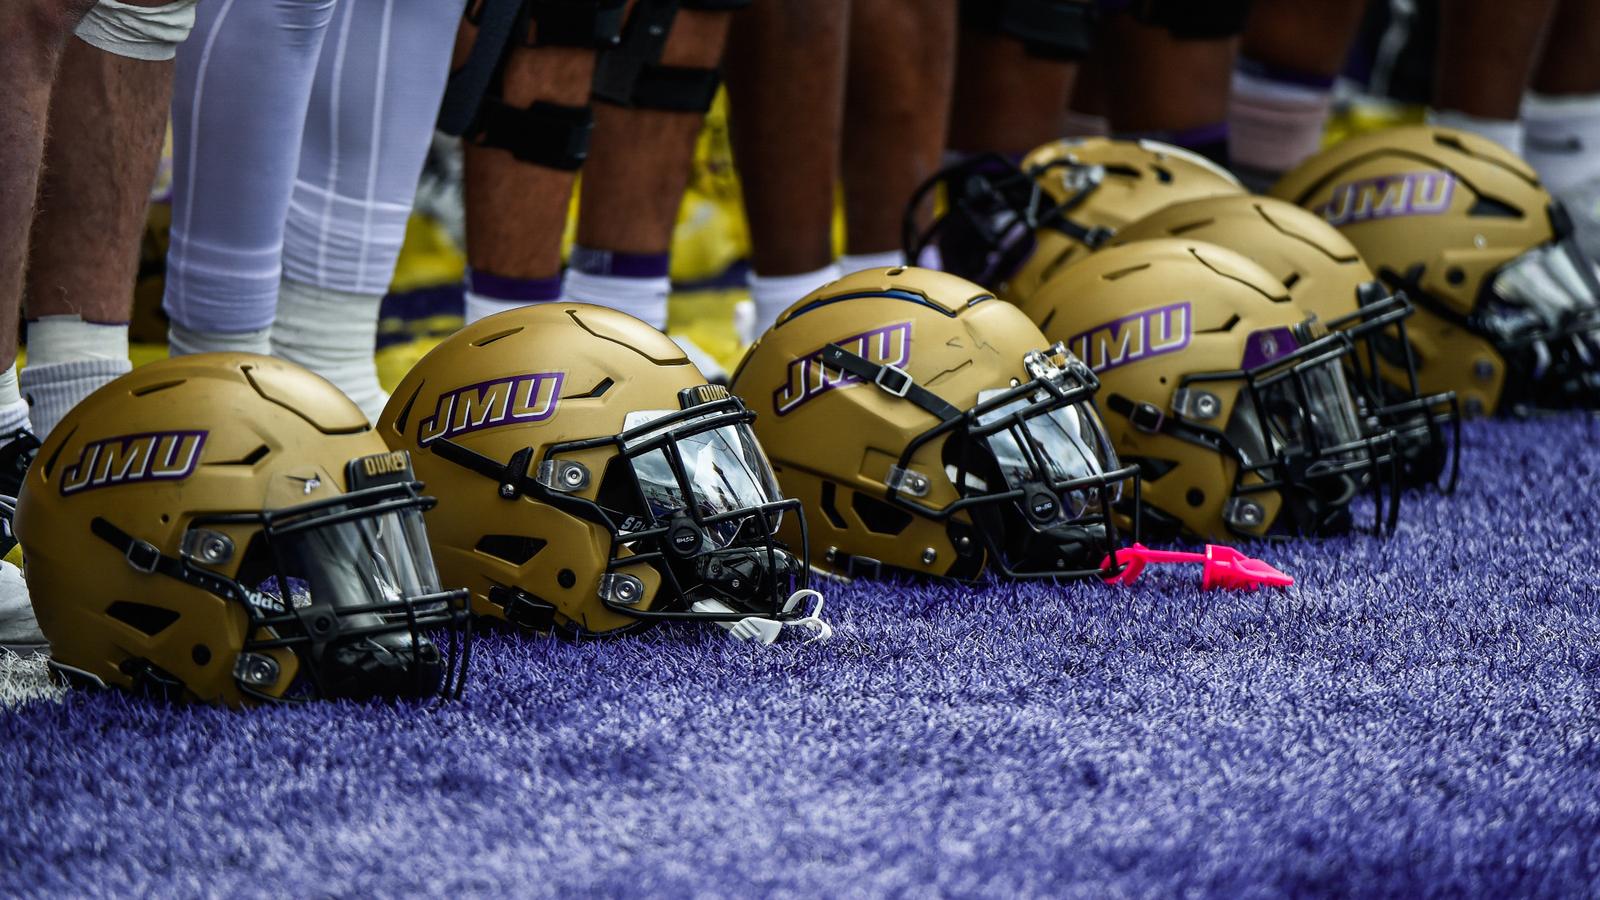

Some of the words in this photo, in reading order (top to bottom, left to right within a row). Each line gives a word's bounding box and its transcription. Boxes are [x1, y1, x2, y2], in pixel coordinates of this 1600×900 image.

[1319, 172, 1454, 226] JMU
[419, 375, 561, 445] JMU
[62, 432, 205, 494] JMU
